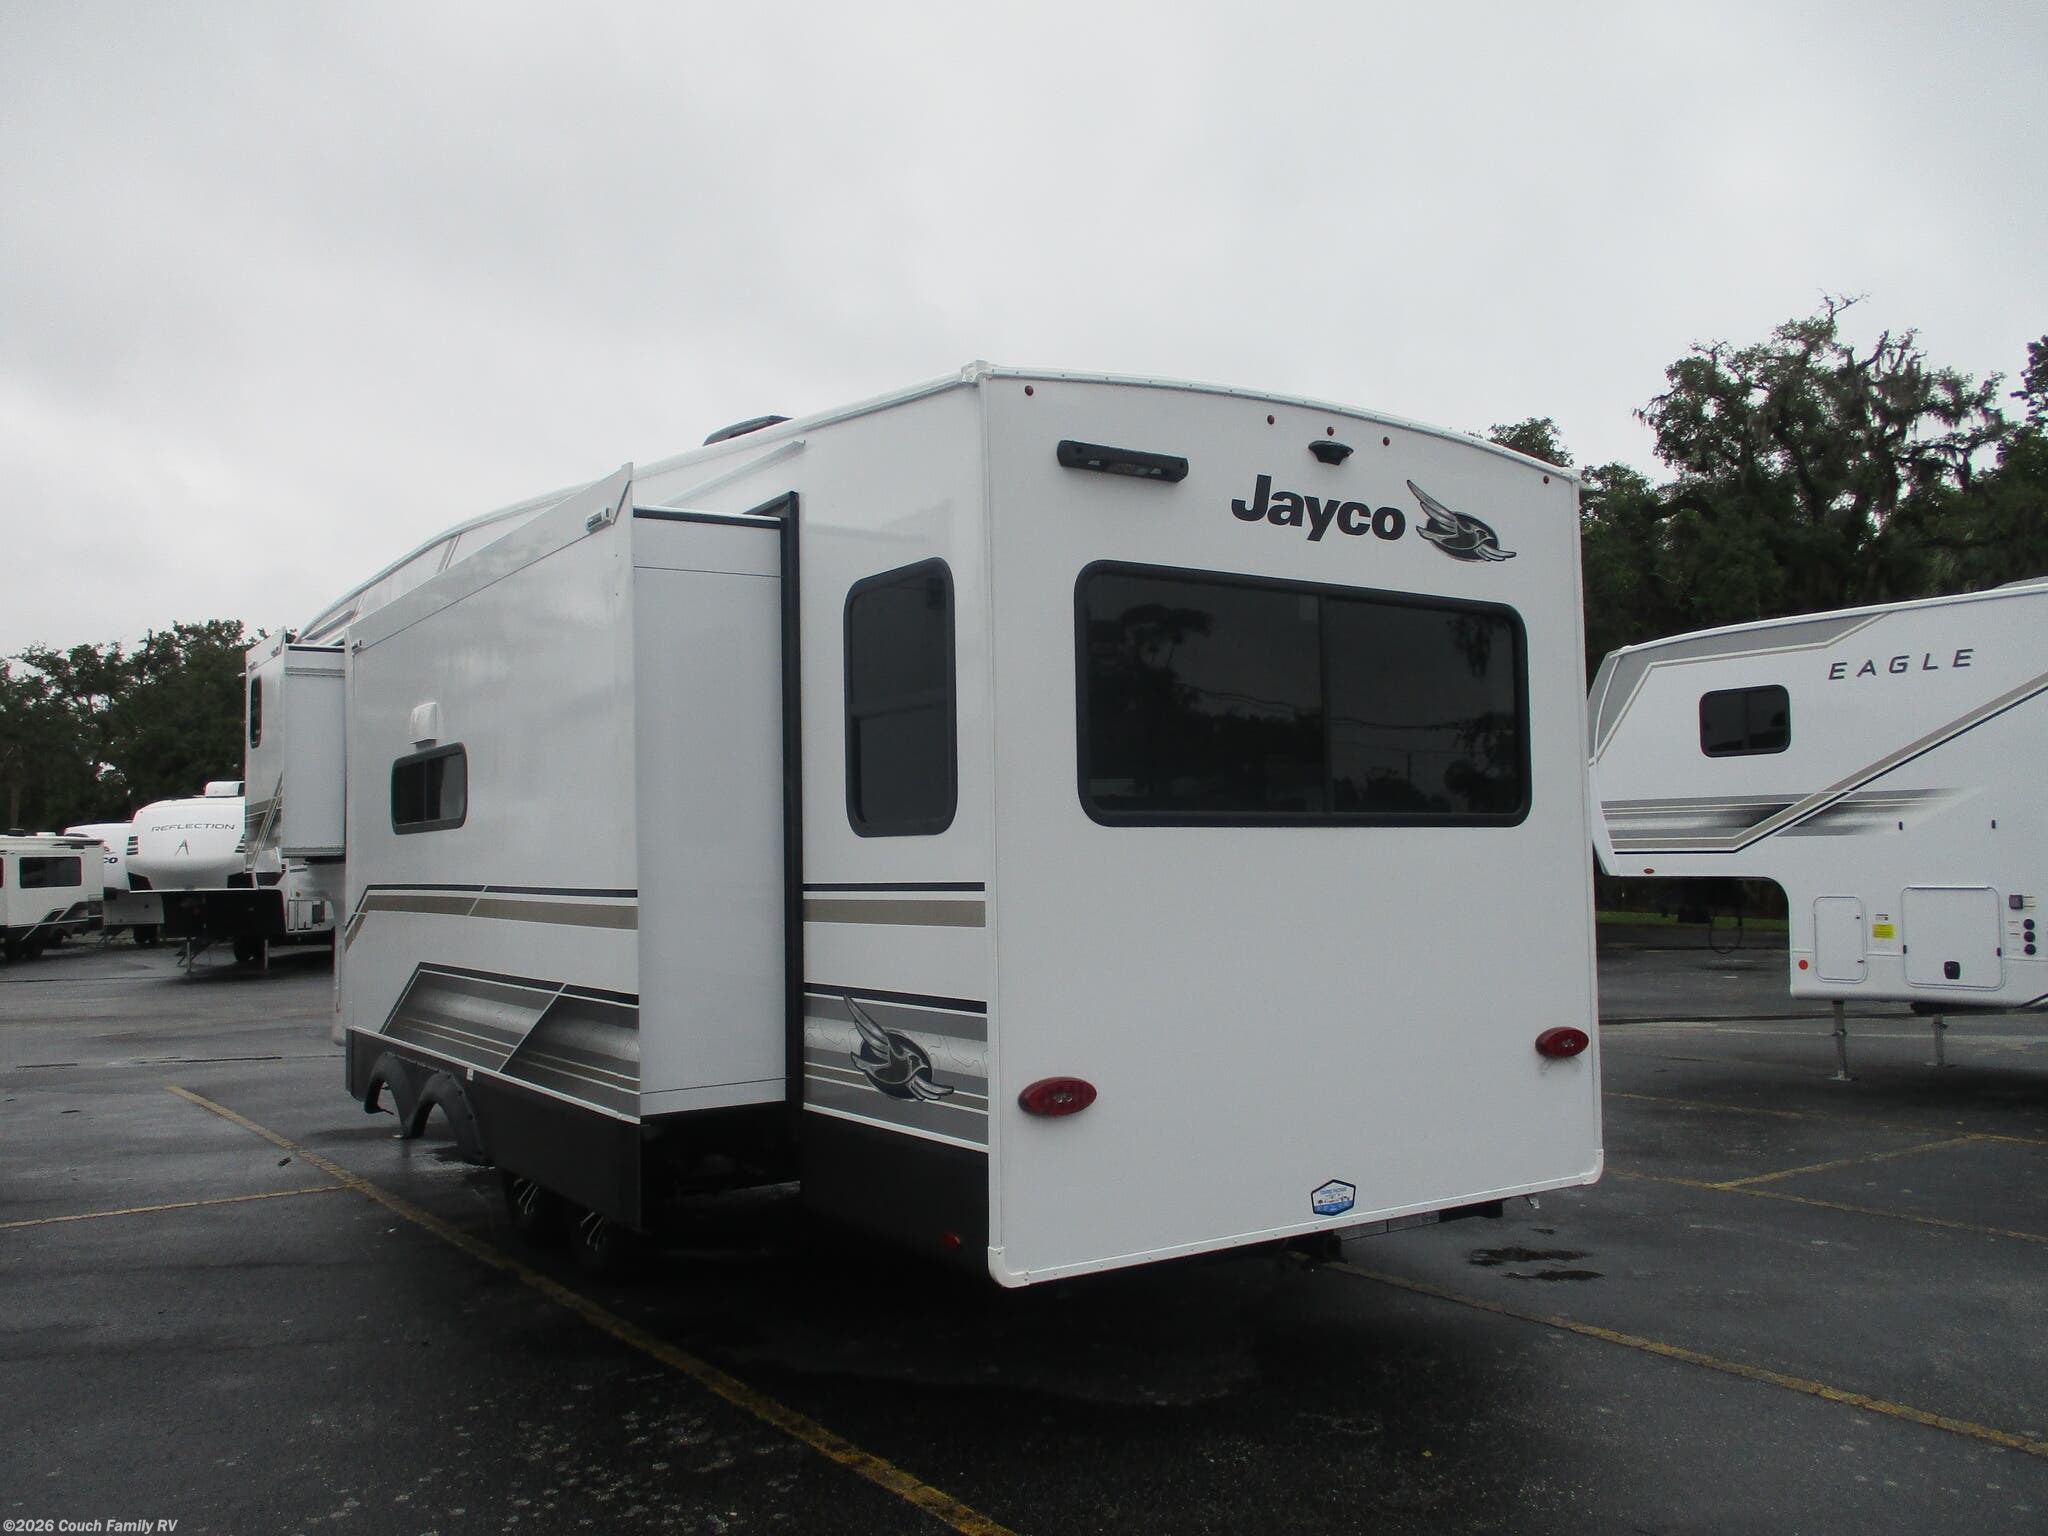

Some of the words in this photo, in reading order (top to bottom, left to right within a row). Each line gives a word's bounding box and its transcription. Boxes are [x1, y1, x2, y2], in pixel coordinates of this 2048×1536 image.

[1231, 474, 1406, 541] Jayco
[1828, 648, 1974, 680] EAGLE
[151, 823, 236, 832] REFLECTION
